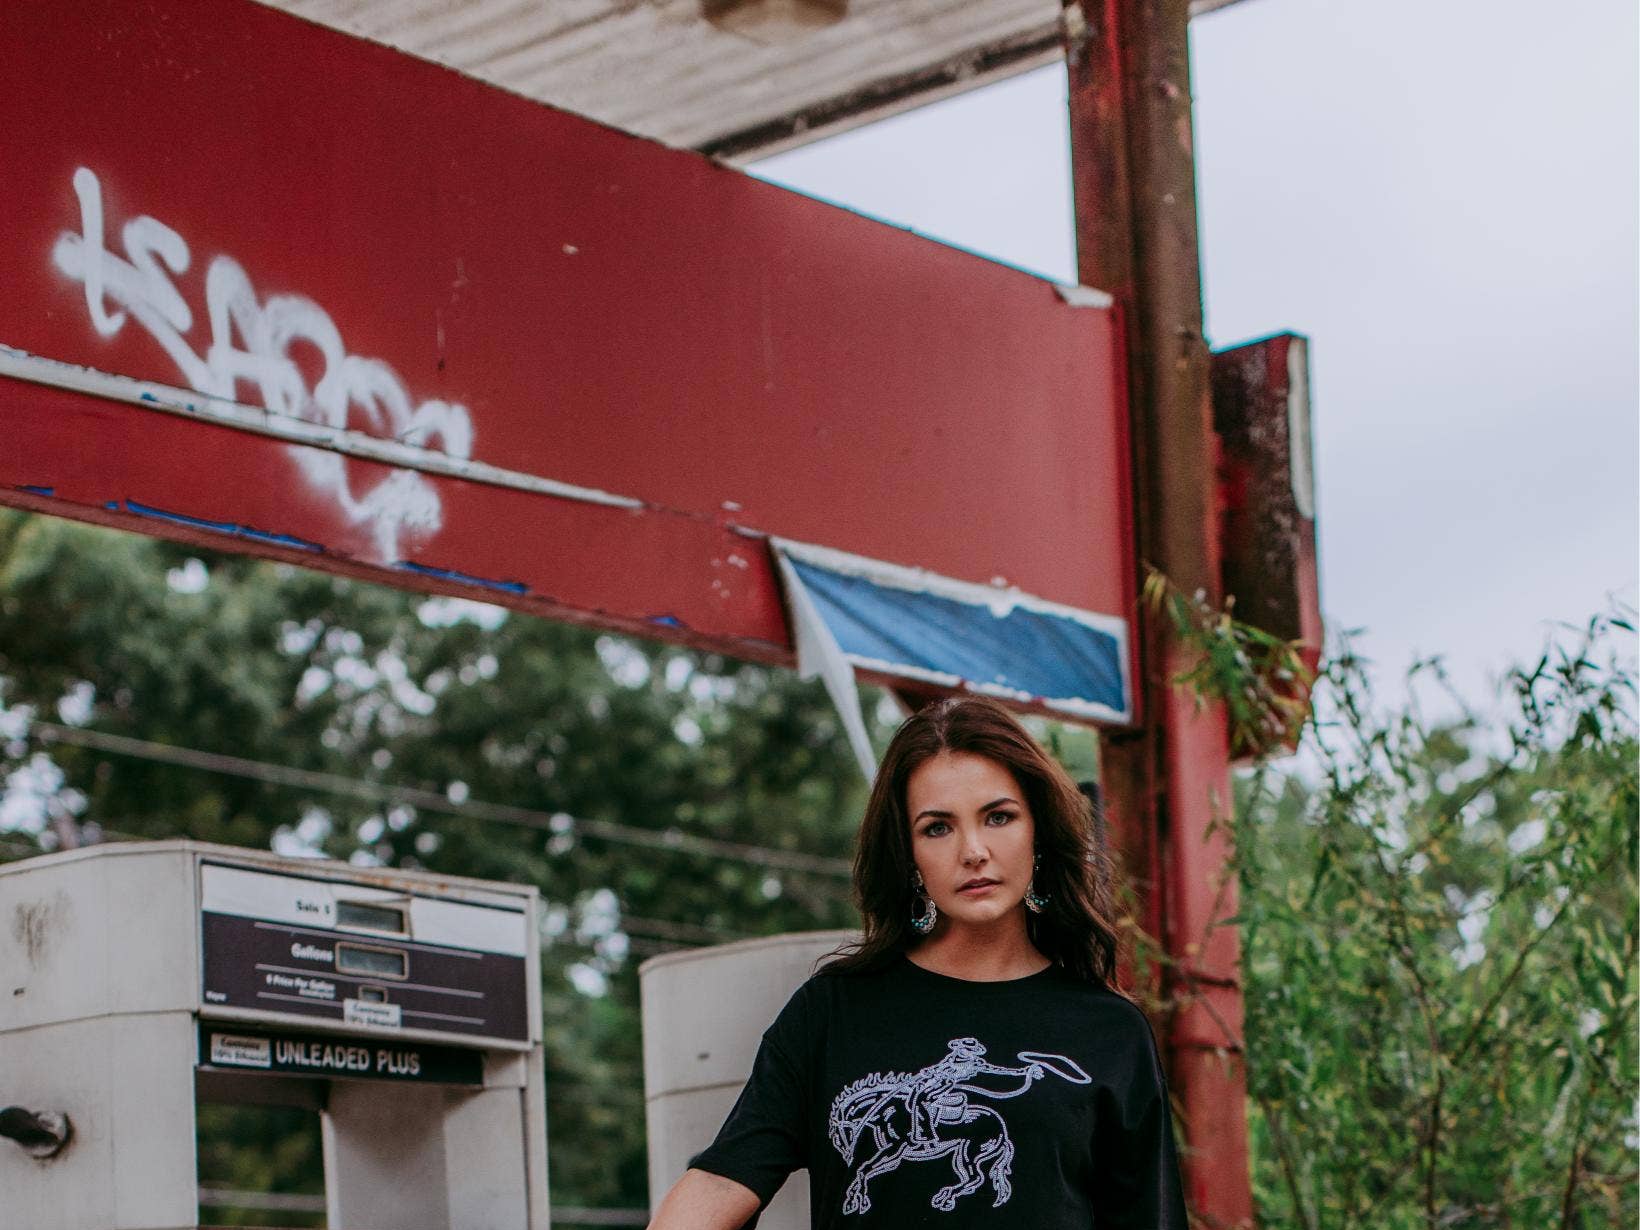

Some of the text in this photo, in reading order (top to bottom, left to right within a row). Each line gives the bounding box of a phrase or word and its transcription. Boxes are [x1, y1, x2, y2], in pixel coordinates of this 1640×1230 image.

[291, 942, 334, 962] Gallons
[275, 1039, 422, 1075] UNLEADED PLUS
